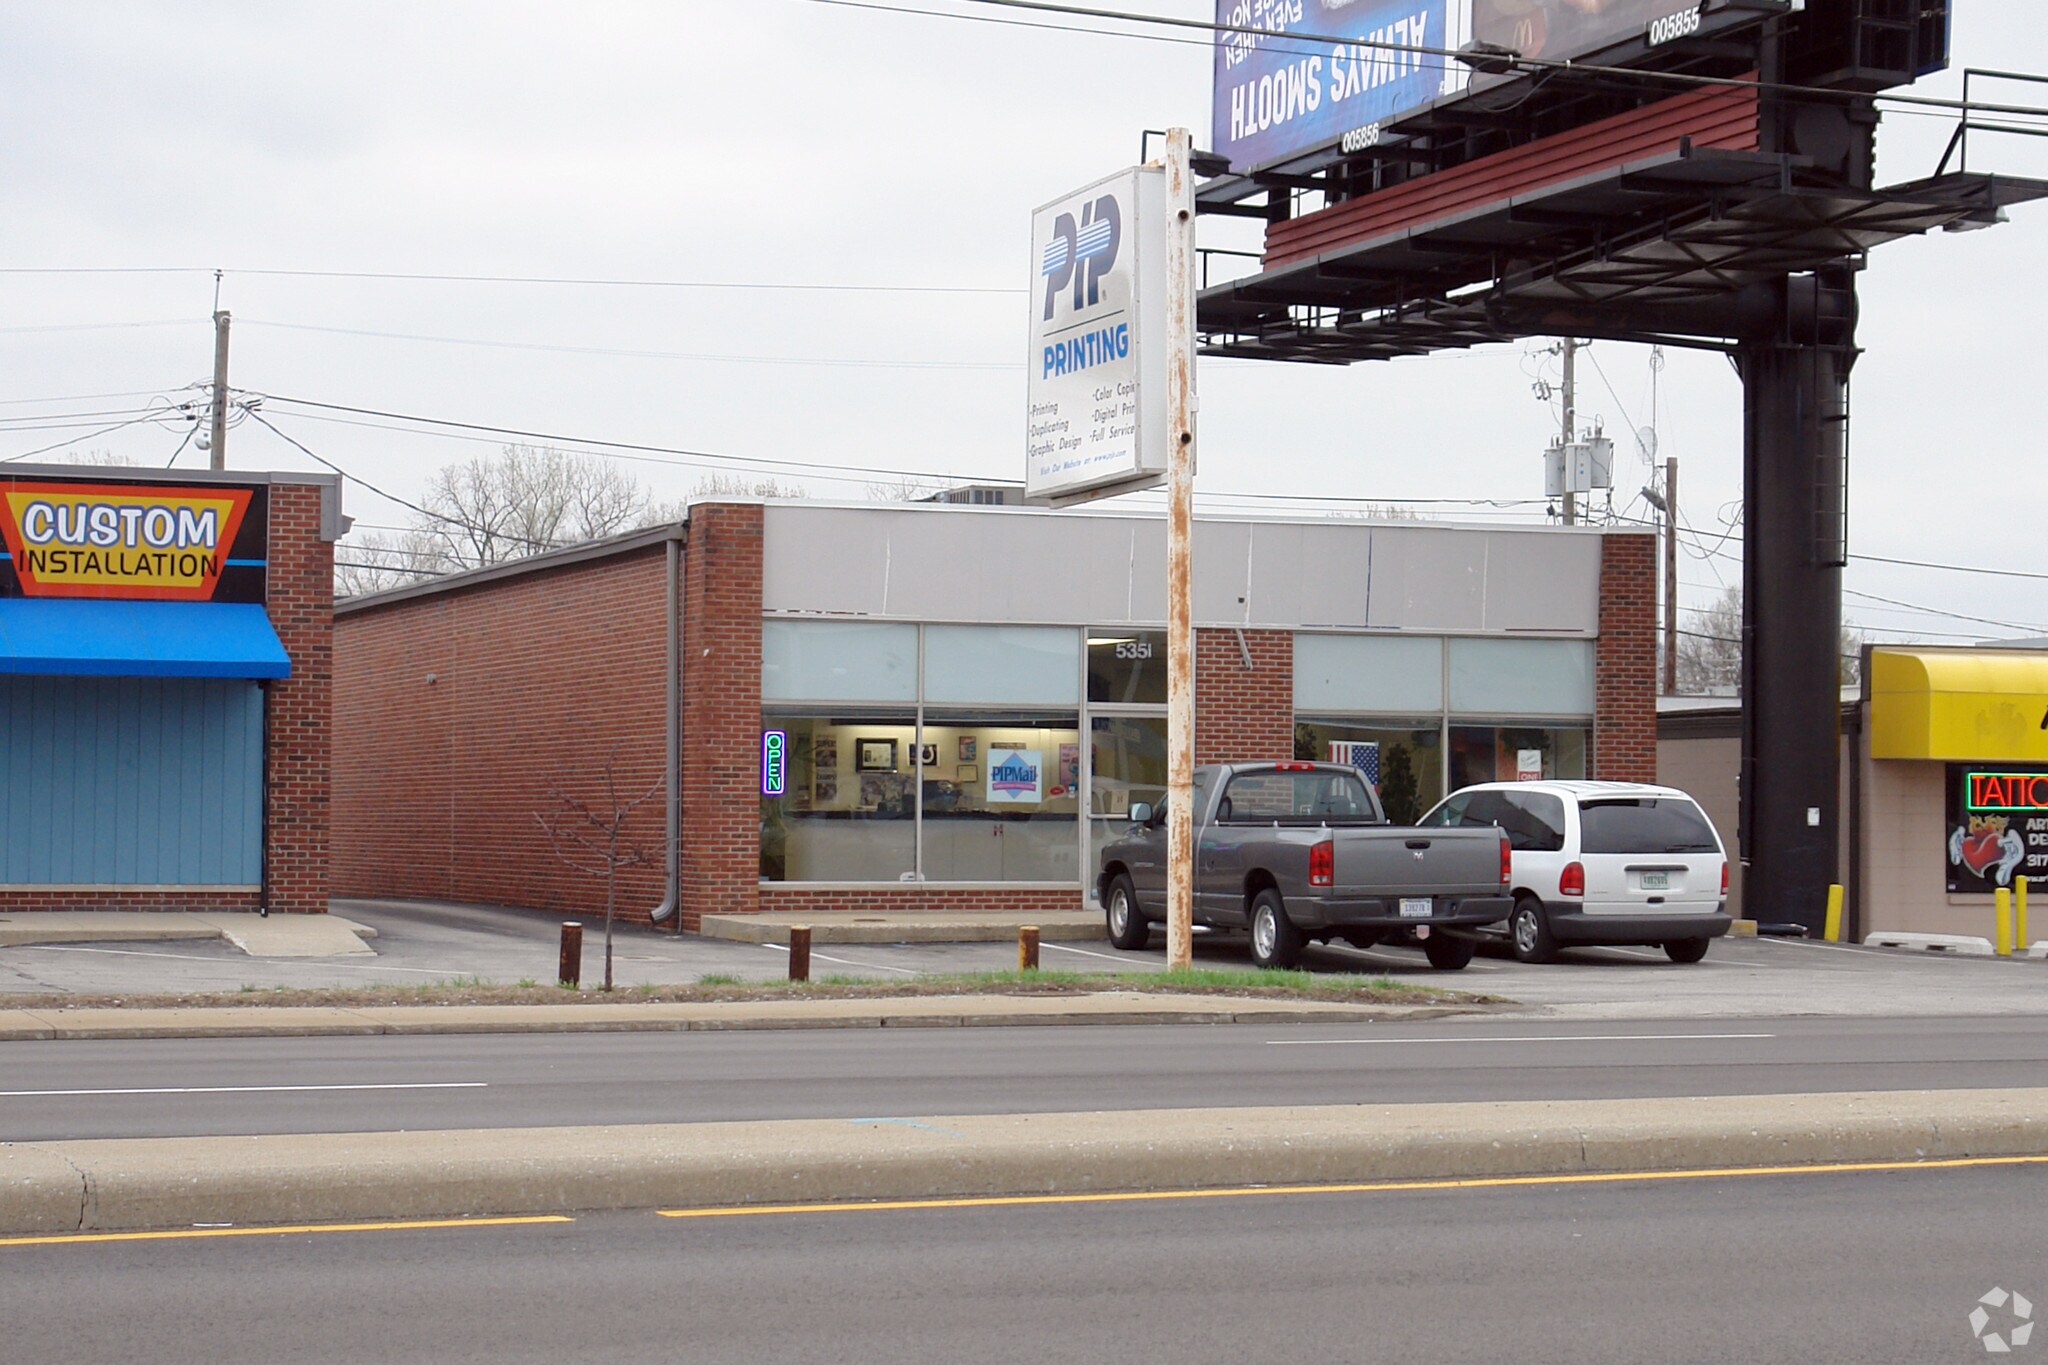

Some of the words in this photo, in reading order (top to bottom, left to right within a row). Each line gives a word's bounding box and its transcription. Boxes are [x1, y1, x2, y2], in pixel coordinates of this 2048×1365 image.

[1651, 6, 1700, 44] 005855
[1330, 10, 1428, 102] ALWAYS
[1230, 55, 1323, 142] SMOOTH
[1342, 122, 1380, 153] 005856
[1042, 194, 1121, 321] PIP
[1043, 322, 1129, 380] PRINTING
[1059, 435, 1082, 450] Design
[23, 501, 218, 548] CUSTOM
[18, 549, 219, 577] INSTALLATION
[1116, 643, 1152, 659] 5351
[767, 734, 782, 790] OPEN
[992, 765, 1037, 782] PIPMail
